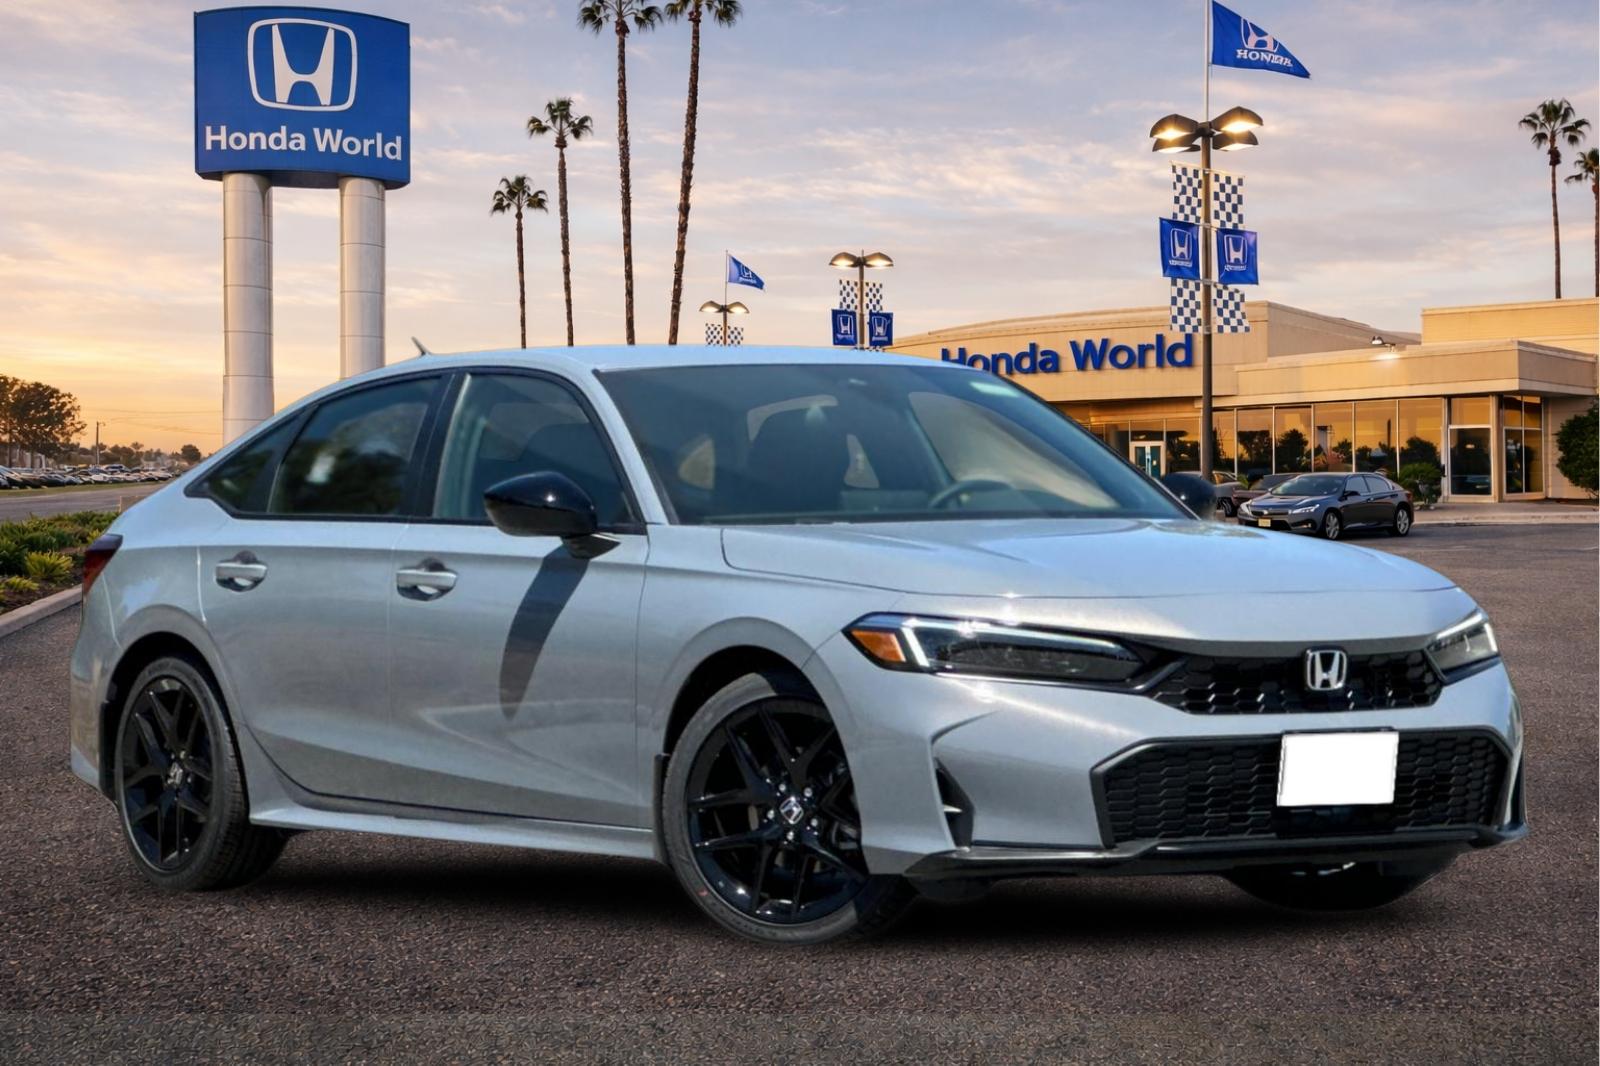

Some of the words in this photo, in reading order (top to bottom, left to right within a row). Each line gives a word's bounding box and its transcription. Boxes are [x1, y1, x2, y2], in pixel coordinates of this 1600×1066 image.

[205, 125, 306, 151] Honda
[313, 127, 402, 160] World
[941, 342, 1060, 375] Honda
[1069, 333, 1193, 371] World
